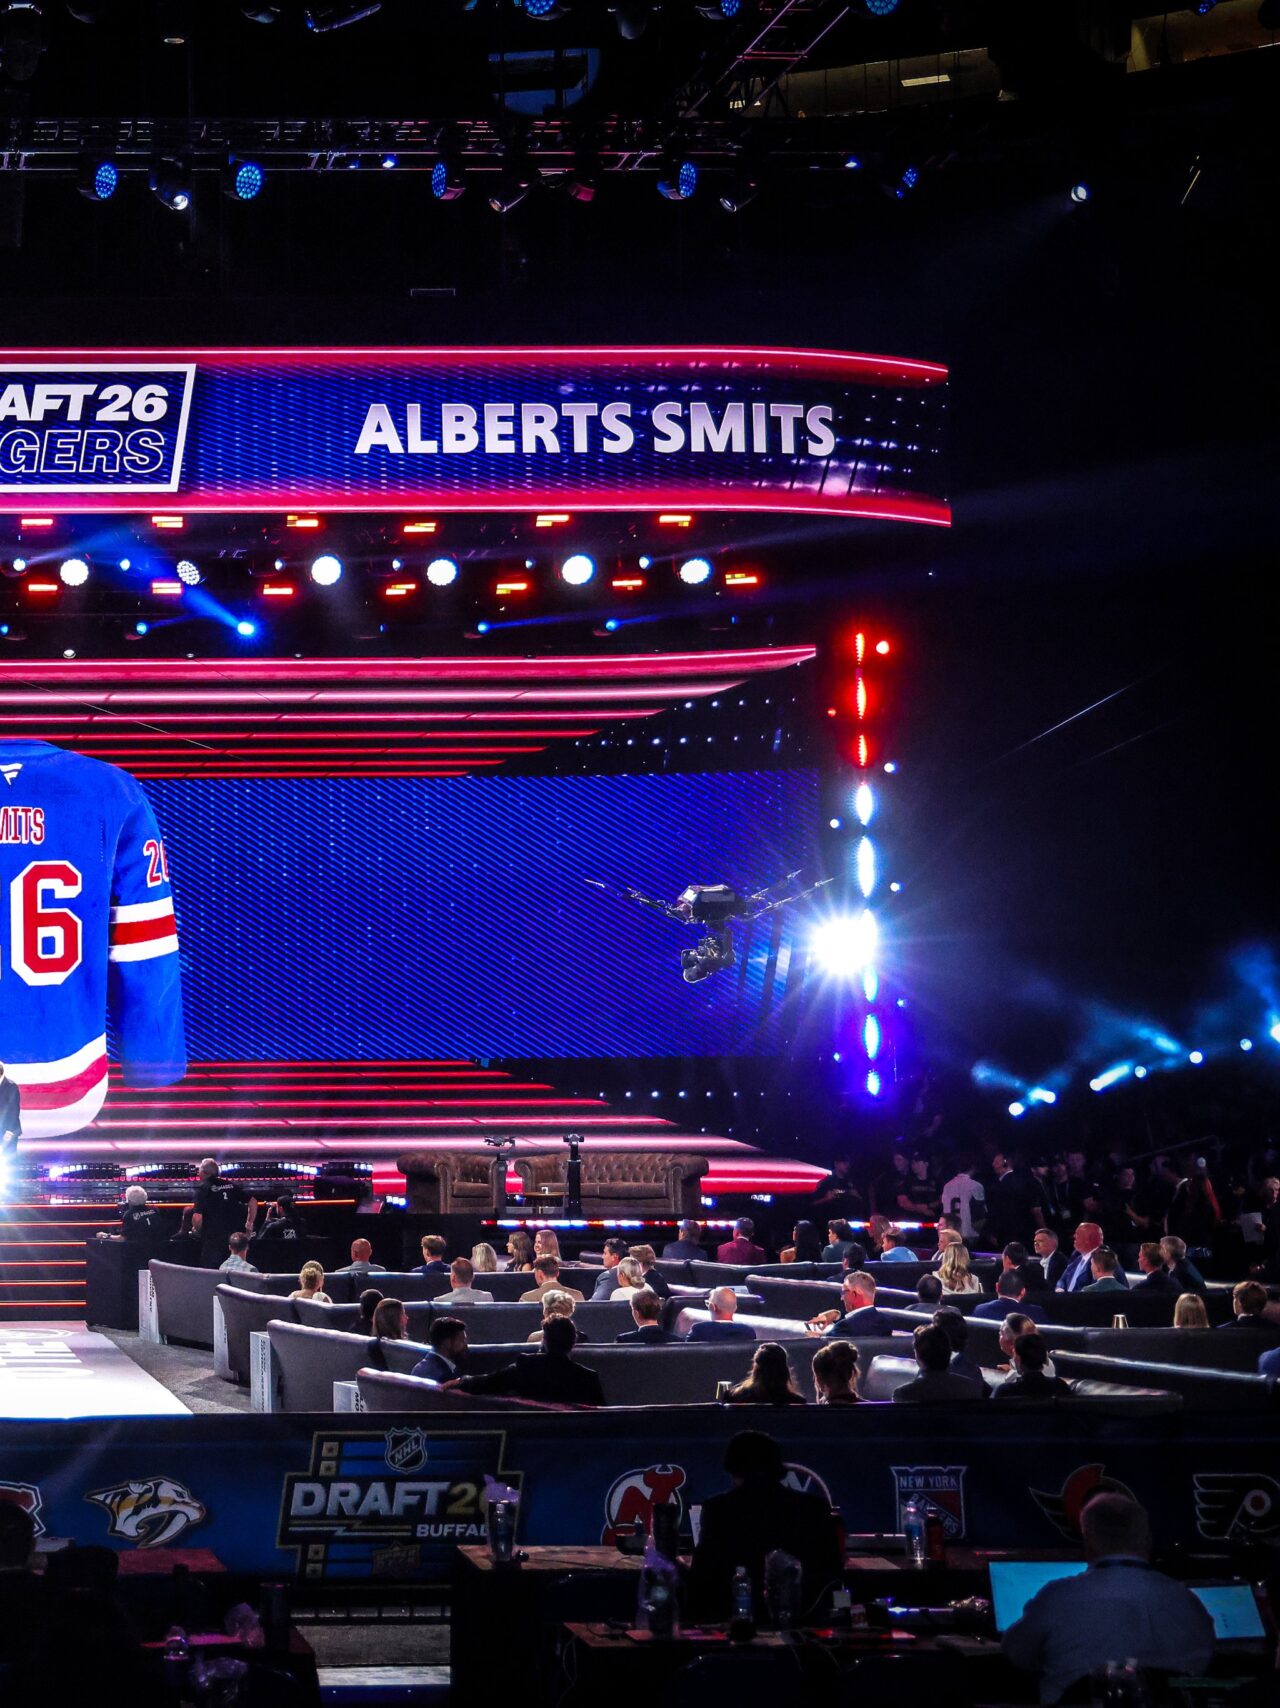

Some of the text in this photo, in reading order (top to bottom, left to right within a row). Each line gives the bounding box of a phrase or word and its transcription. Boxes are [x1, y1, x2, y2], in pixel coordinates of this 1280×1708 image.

[95, 384, 168, 421] 26
[354, 402, 836, 456] ALBERTS SMITS
[290, 1482, 451, 1517] DRAFT
[900, 1475, 957, 1489] NEW YORK
